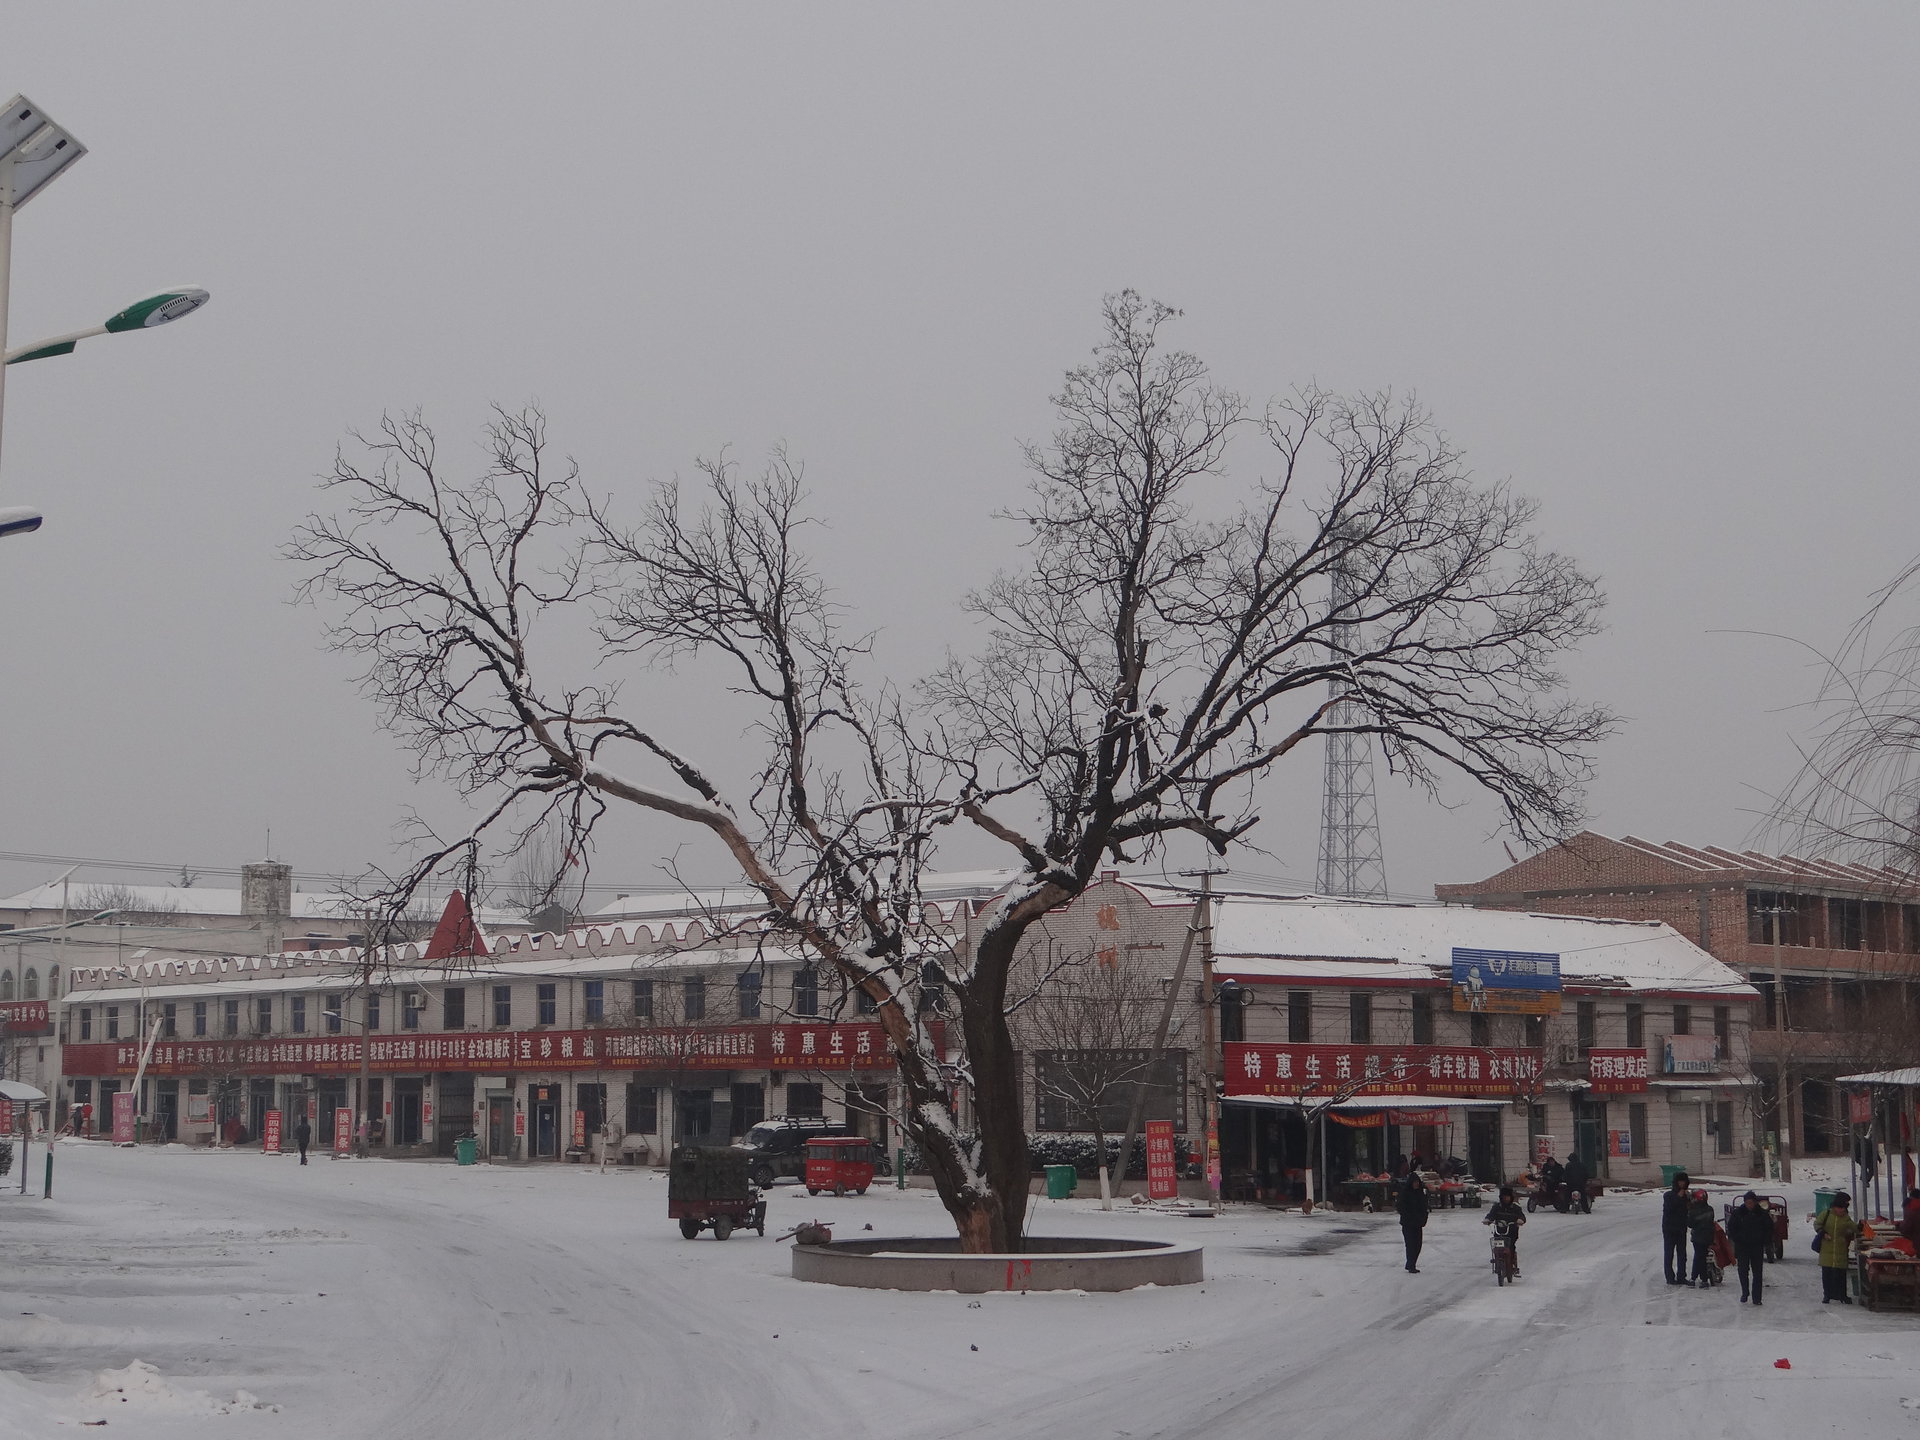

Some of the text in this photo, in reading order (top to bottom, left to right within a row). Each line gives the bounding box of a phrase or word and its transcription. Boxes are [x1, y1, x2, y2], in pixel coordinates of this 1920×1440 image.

[468, 1038, 510, 1060] 金玫瑰婚庆
[521, 1036, 594, 1059] 宝珍粮油
[1244, 1051, 1408, 1079] 特惠生活超市
[1429, 1054, 1480, 1079] 轿车轮胎
[338, 1112, 350, 1148] 换面条
